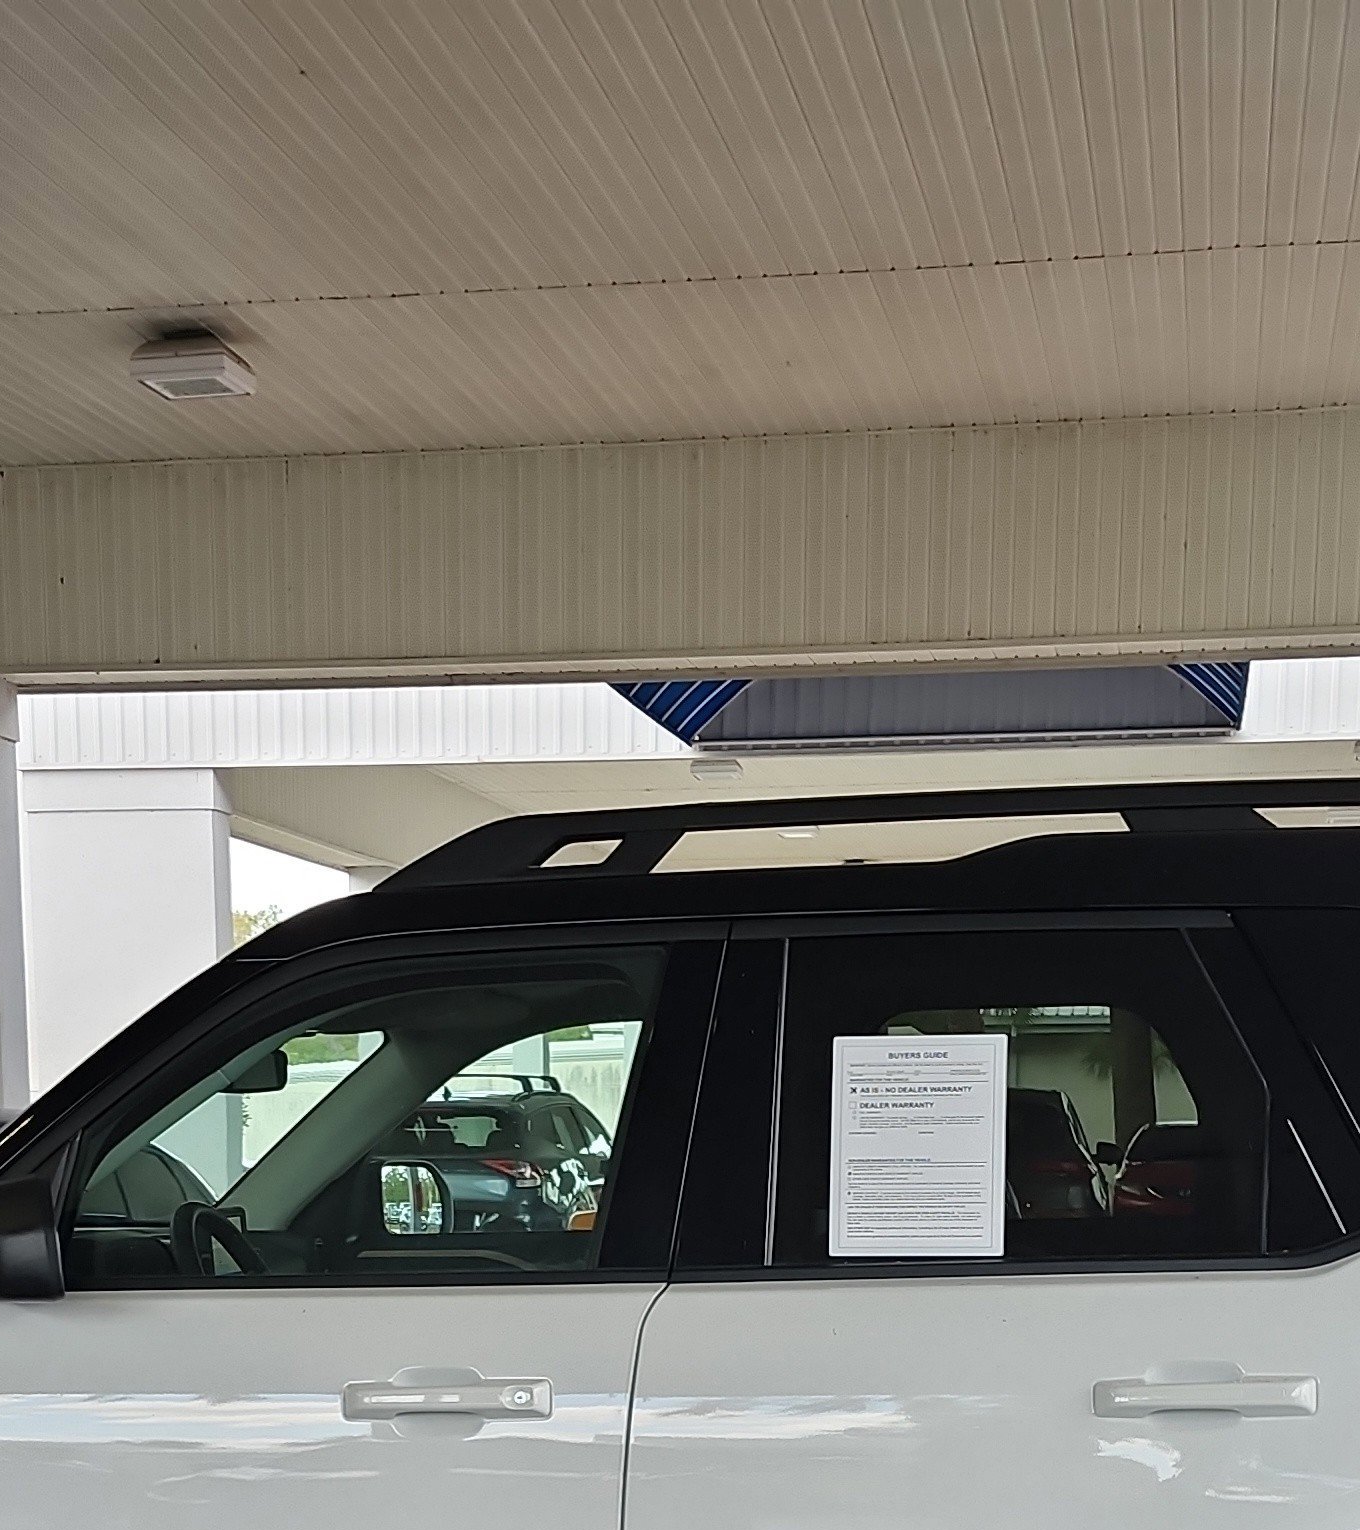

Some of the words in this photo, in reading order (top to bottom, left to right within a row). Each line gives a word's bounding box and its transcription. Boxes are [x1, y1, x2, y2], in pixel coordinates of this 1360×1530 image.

[887, 1051, 922, 1060] BUYERS
[923, 1051, 949, 1059] GUIDE
[891, 1101, 935, 1109] WARRANTY
